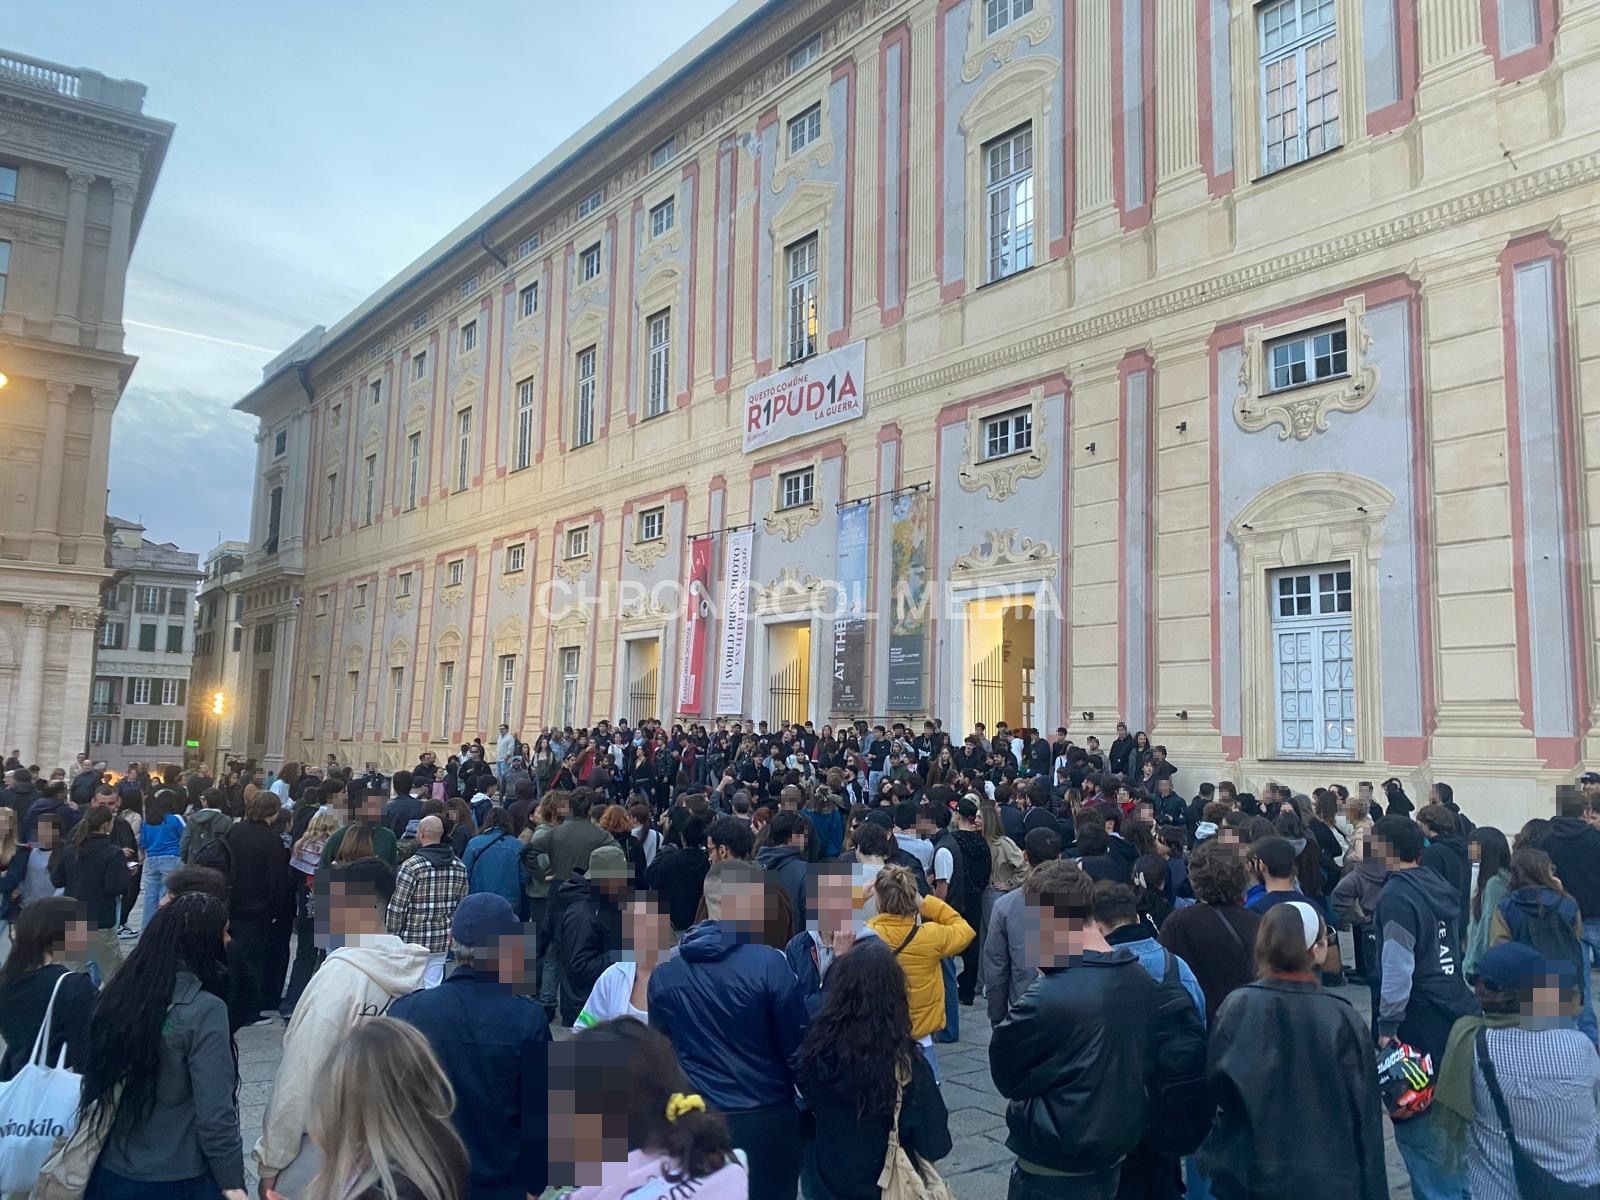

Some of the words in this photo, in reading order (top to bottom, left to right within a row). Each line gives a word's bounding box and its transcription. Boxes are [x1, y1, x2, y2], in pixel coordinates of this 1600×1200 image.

[747, 370, 857, 433] R1PUD1A
[749, 387, 775, 404] QUESTO
[776, 374, 809, 393] COMUNE
[814, 411, 824, 421] LA
[826, 399, 859, 417] GUERRA
[731, 547, 741, 590] PHOTO
[728, 594, 738, 630] PRESS
[735, 580, 746, 666] EXHIBITION
[835, 620, 847, 656] THE
[725, 634, 735, 679] WORLD
[834, 659, 845, 681] AT
[1284, 696, 1354, 713] GIFT
[1439, 944, 1455, 976] AIR
